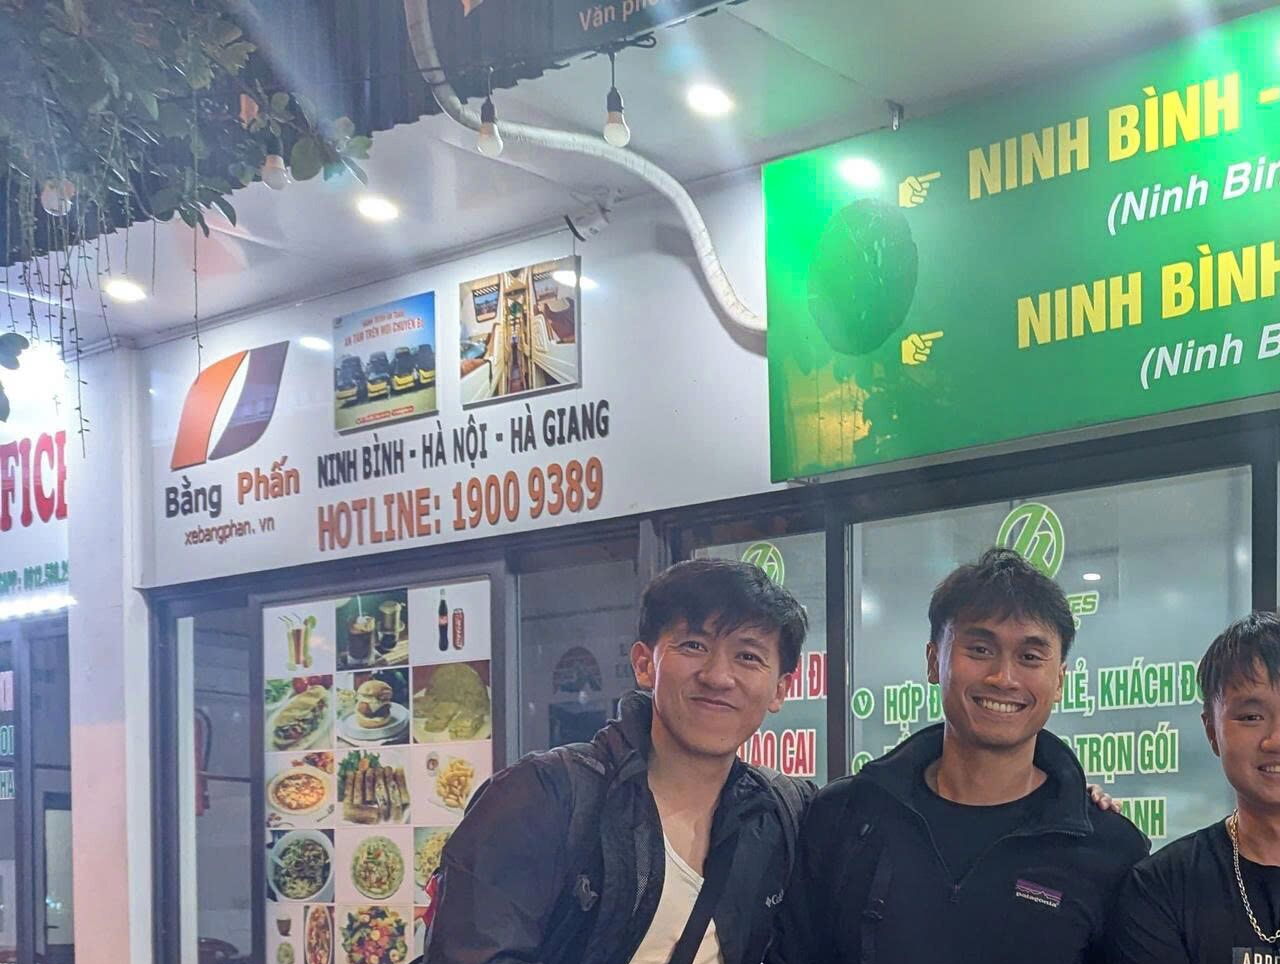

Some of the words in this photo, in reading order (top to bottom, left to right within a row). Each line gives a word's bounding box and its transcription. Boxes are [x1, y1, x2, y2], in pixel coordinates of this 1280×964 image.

[968, 116, 1089, 200] NINH
[1108, 73, 1240, 162] BÌNH
[1106, 177, 1209, 236] (Ninh
[1018, 270, 1142, 349] NINH
[1140, 336, 1244, 389] (Ninh
[317, 450, 358, 488] NINH
[362, 433, 405, 477] BÌNH
[421, 420, 447, 468] HÀ
[453, 421, 488, 468] NỘI
[510, 402, 536, 453] HÀ
[542, 400, 610, 446] GIANG
[164, 474, 222, 518] Bằng
[236, 455, 300, 505] Phấn
[317, 486, 442, 551] HOTLINE:
[450, 469, 520, 531] 1900
[527, 456, 604, 519] 9389
[258, 515, 276, 534] vn
[884, 680, 924, 732] HỢP
[1098, 656, 1176, 711] KHÁCH
[780, 728, 816, 778] CAI
[1075, 731, 1135, 784] TRỌN
[1137, 721, 1179, 775] GÓI
[1015, 891, 1057, 908] patagonia
